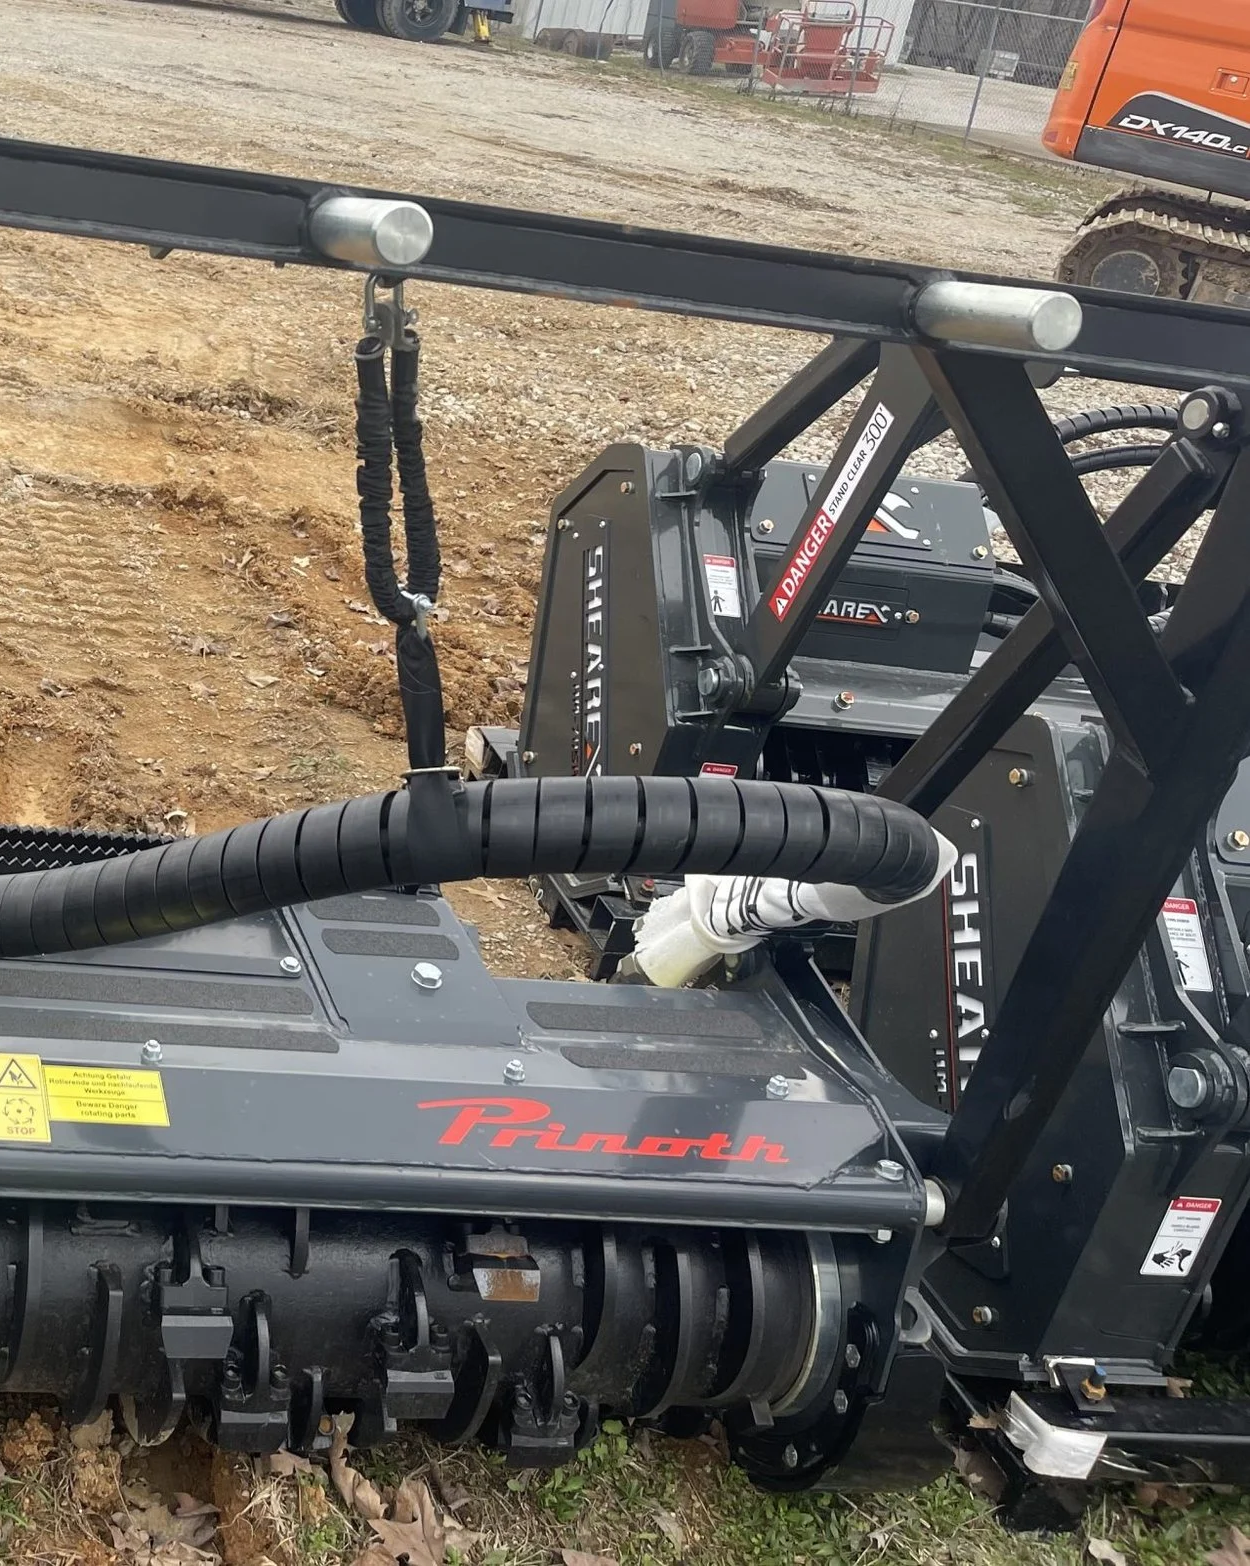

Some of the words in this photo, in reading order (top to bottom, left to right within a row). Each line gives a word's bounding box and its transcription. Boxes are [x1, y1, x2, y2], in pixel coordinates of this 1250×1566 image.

[781, 513, 833, 597] DANGER
[828, 481, 849, 515] STAND
[847, 450, 868, 482] CLEAR
[818, 600, 891, 623] AREX
[73, 1071, 105, 1080] Achtung
[76, 1100, 107, 1108] Beware
[108, 1102, 138, 1110] Danger
[81, 1110, 113, 1118] rotating
[6, 1126, 36, 1136] STOP
[416, 1096, 790, 1163] Prinoth
